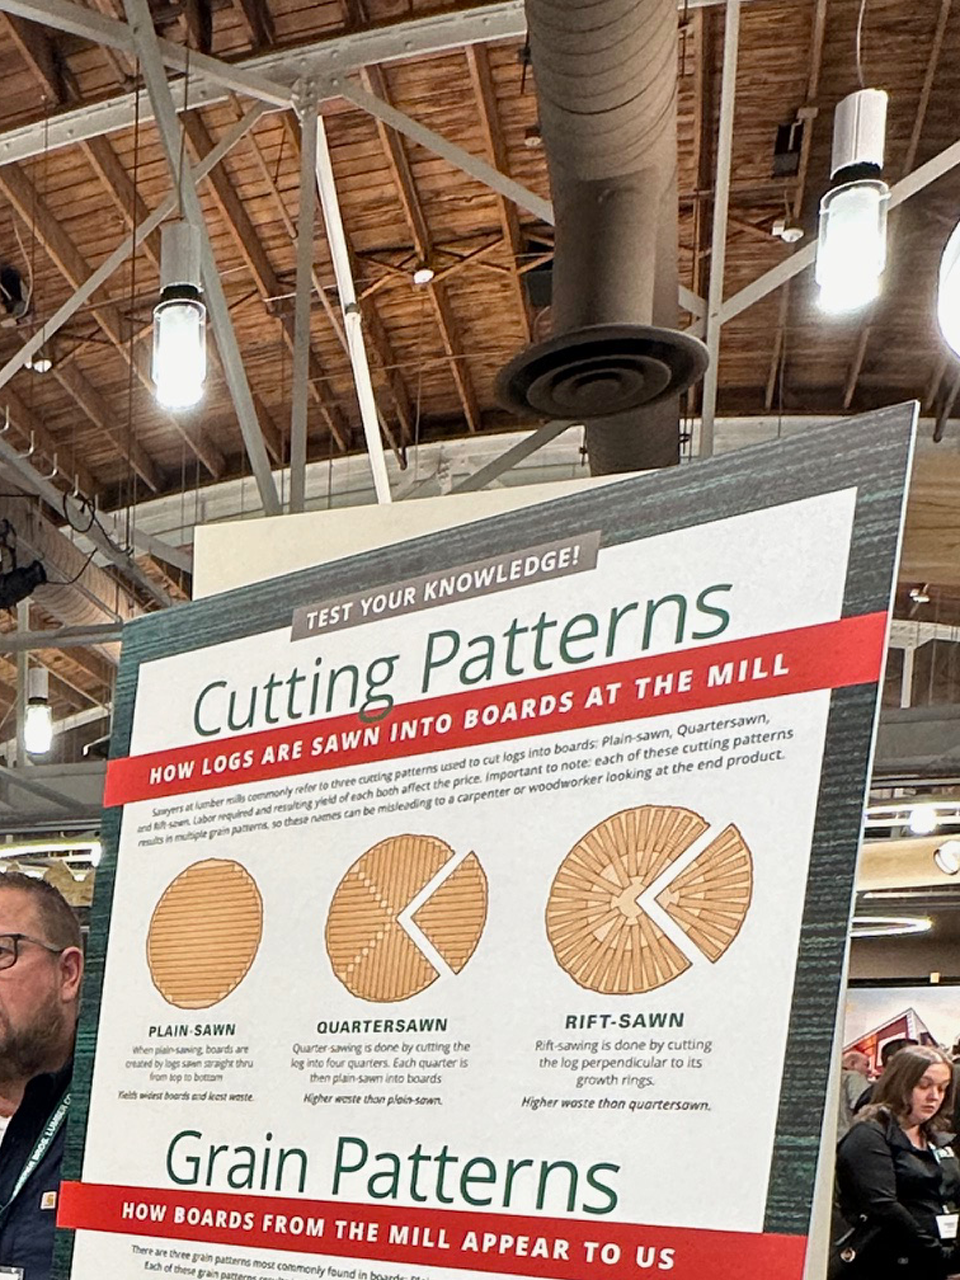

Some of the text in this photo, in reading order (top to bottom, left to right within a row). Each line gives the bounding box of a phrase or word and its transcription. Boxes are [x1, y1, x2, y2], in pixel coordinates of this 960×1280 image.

[306, 544, 580, 630] TEST YOUR KNOWLEDGE!
[193, 583, 733, 736] Cutting Patterns
[149, 652, 789, 785] HOW LOGS ARE SAWN INTO BOARDS AT THE MILL
[330, 713, 770, 789] three cutting patterns used to cut logs into boards: Plain-sawn, Quartersawn,
[349, 728, 794, 802] each both affect the price. Important to note: each of these cutting patterns
[343, 749, 785, 819] can be misleading to a carpenter or woodworker looking at the end product.
[148, 1023, 236, 1038] PLAIN-SAWN
[316, 1017, 448, 1034] QUARTERSAWN
[564, 1012, 684, 1029] RIFT-SAWN
[291, 1040, 471, 1056] Quarter-sawing is done by cutting the
[534, 1038, 713, 1054] Rift-sawing is done by cutting
[289, 1057, 305, 1071] log
[305, 1058, 324, 1068] into
[325, 1056, 346, 1068] four
[392, 1056, 417, 1068] Each
[417, 1058, 458, 1070] quarter
[458, 1057, 469, 1068] is
[538, 1055, 703, 1071] the log perpendicular to its
[575, 1073, 655, 1089] growth rings.
[520, 1095, 559, 1111] Higher
[560, 1098, 595, 1109] waste
[597, 1097, 626, 1109] than
[46, 1104, 68, 1136] LUMBER
[166, 1129, 620, 1215] Grain Patterns
[121, 1201, 675, 1270] HOW BOARDS FROM THE MILL APPEAR TO US
[130, 1244, 154, 1256] There
[154, 1248, 168, 1258] are
[168, 1248, 191, 1260] three
[190, 1252, 213, 1263] grain
[213, 1255, 251, 1267] patterns
[252, 1259, 276, 1270] most
[276, 1262, 326, 1279] commonly
[326, 1265, 356, 1280] found
[357, 1269, 368, 1280] in
[143, 1260, 162, 1271] Each
[163, 1262, 173, 1273] of
[173, 1264, 196, 1276] these
[196, 1268, 219, 1279] grain
